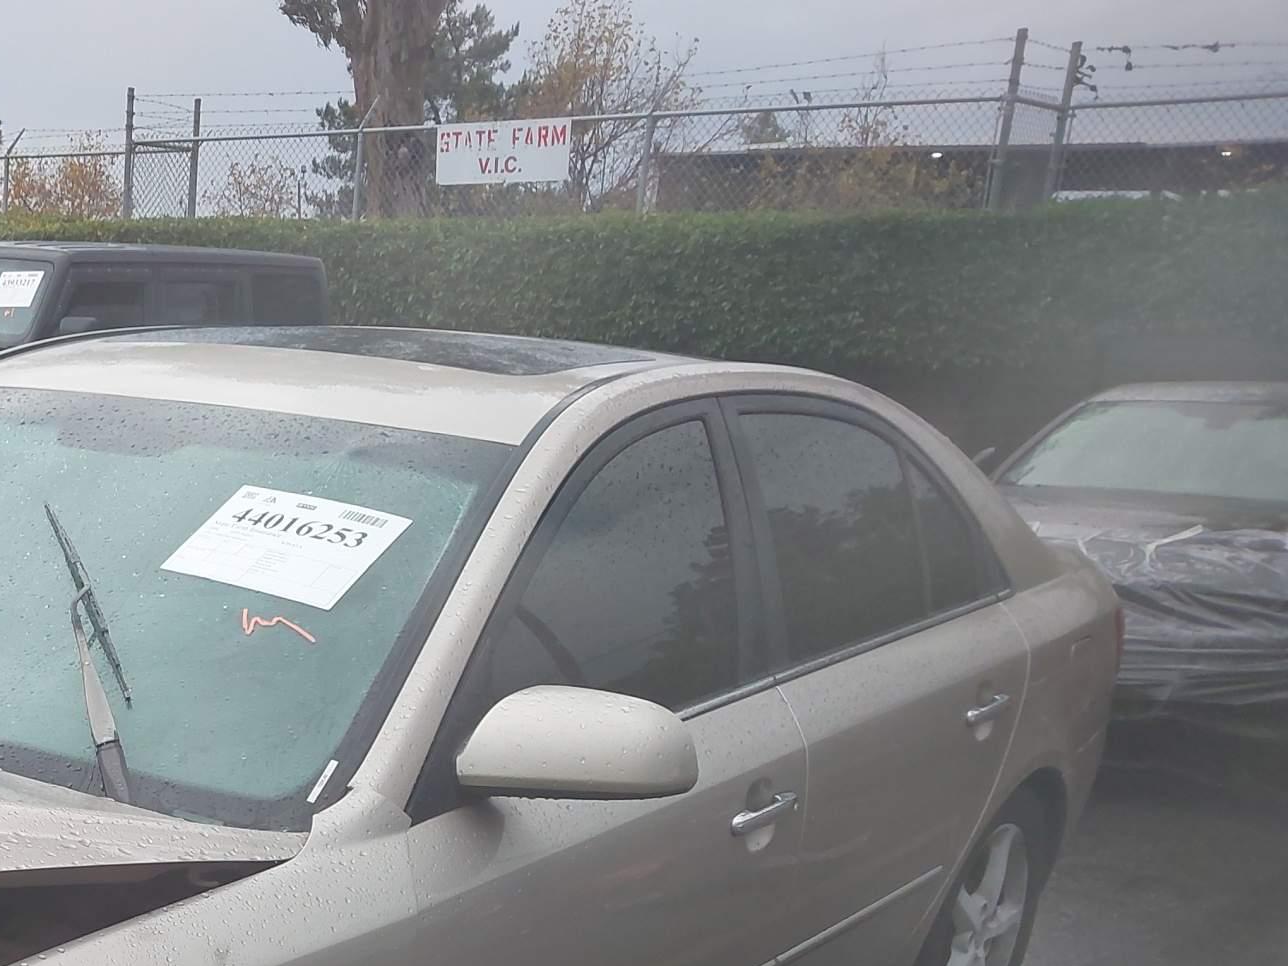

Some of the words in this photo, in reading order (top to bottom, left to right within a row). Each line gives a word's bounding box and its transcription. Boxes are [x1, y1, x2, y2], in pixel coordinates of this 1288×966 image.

[440, 131, 499, 153] STATE
[512, 124, 567, 148] FARM
[478, 156, 522, 174] V.I.C.
[232, 508, 368, 548] 44016253
